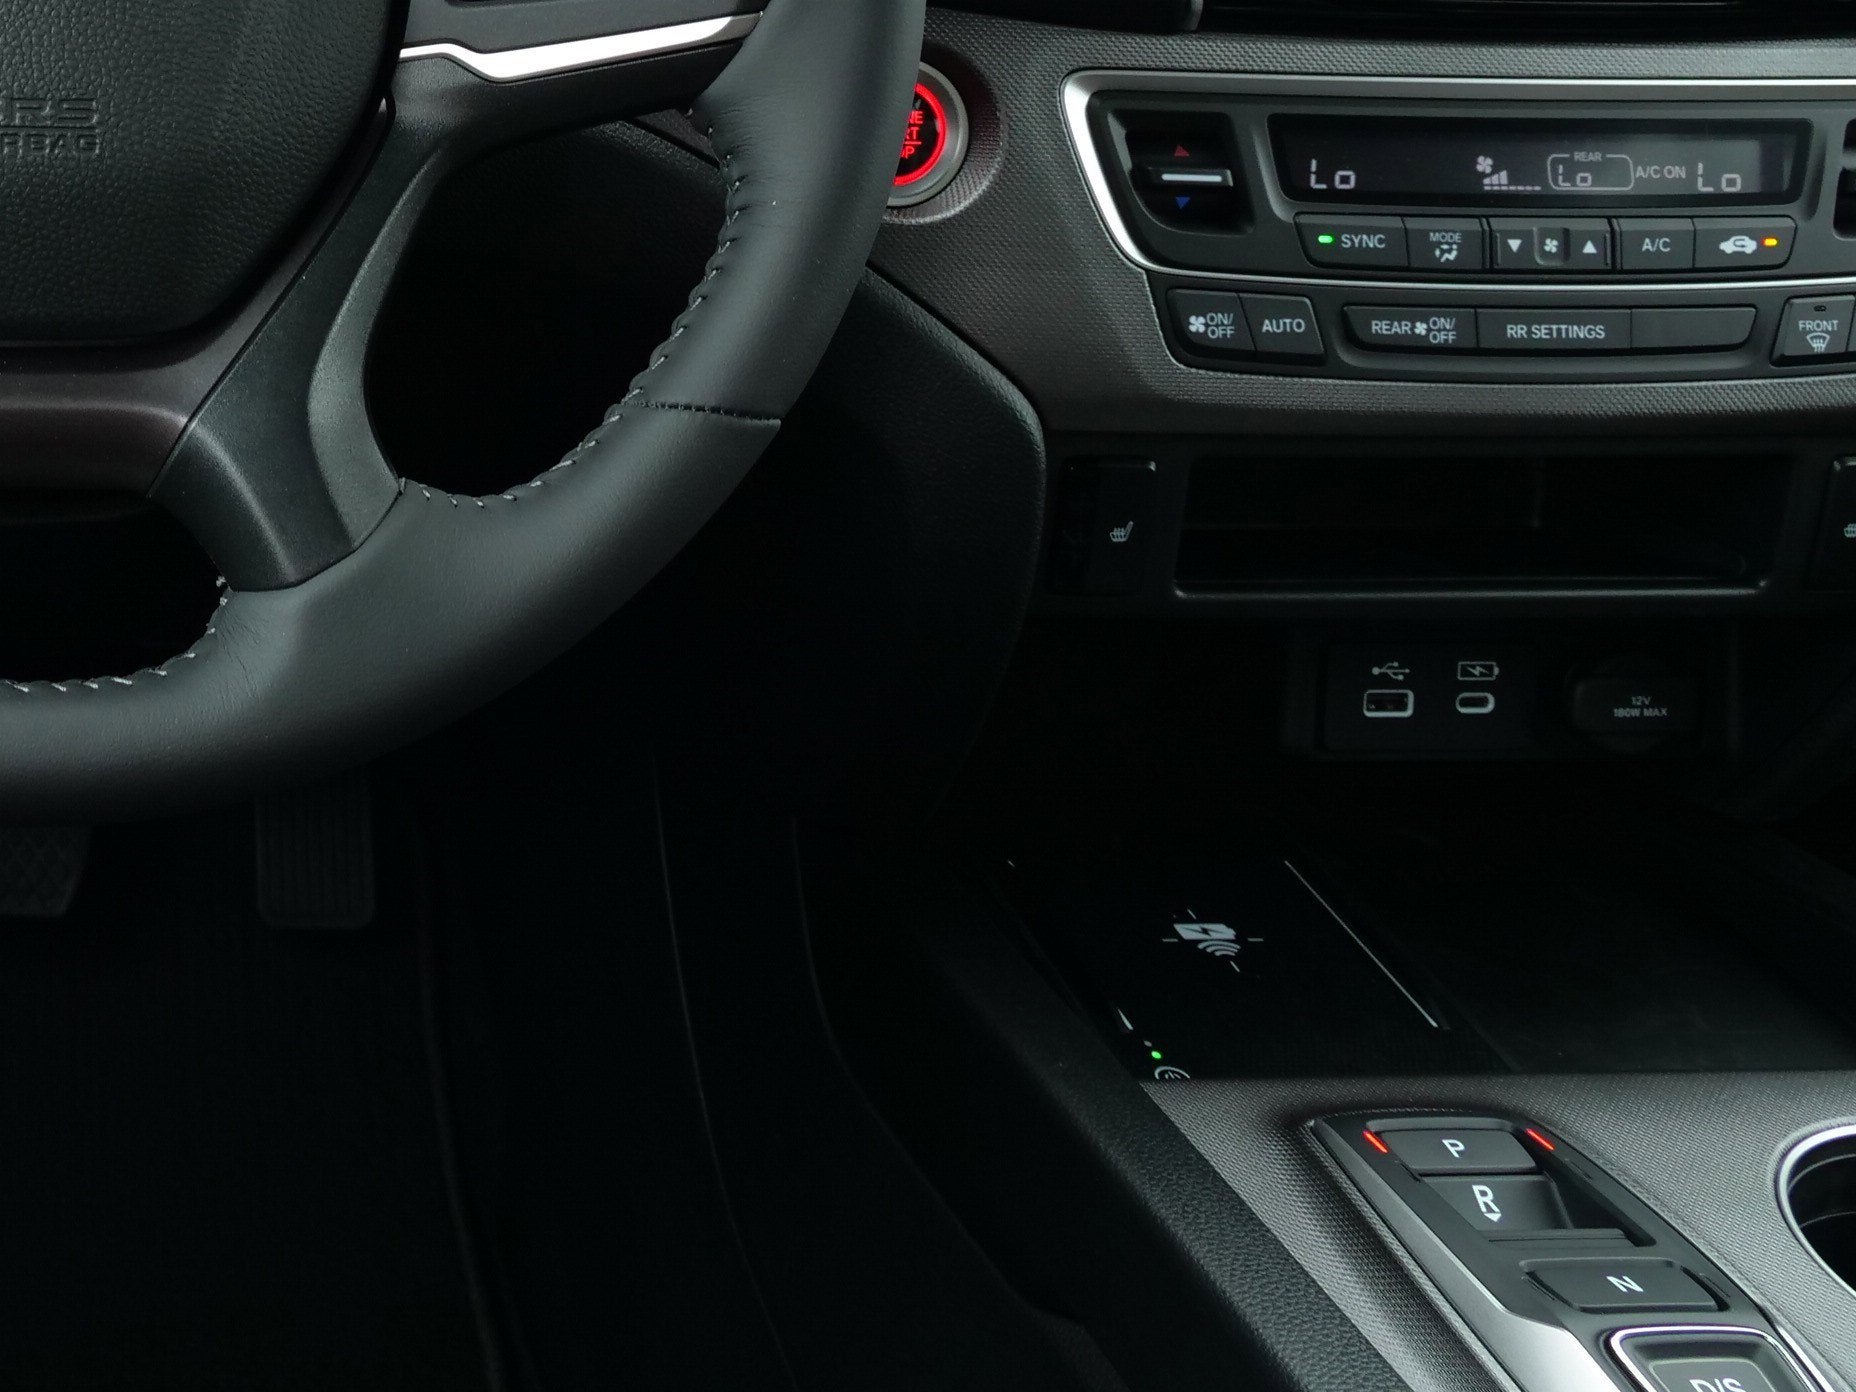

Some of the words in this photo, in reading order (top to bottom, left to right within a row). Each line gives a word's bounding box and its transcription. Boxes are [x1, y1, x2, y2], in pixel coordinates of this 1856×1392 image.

[1574, 151, 1602, 162] REAR
[1635, 165, 1661, 179] A/C
[1663, 166, 1686, 179] ON
[1341, 234, 1385, 250] SYNC
[1429, 232, 1462, 244] MODE
[1641, 237, 1671, 253] A/C
[1206, 312, 1233, 326] ON/
[1262, 318, 1305, 334] AUTO
[1429, 317, 1455, 331] ON/
[1799, 319, 1838, 331] FRONT
[1207, 324, 1235, 339] OFF
[1371, 320, 1411, 335] REAR
[1507, 324, 1529, 339] RR
[1531, 324, 1605, 339] SETTINGS
[1429, 331, 1456, 345] OFF
[1631, 695, 1652, 705] 12V
[1643, 708, 1668, 718] MAX
[1441, 1137, 1466, 1159] P
[1472, 1184, 1499, 1213] R
[1606, 1275, 1644, 1294] N
